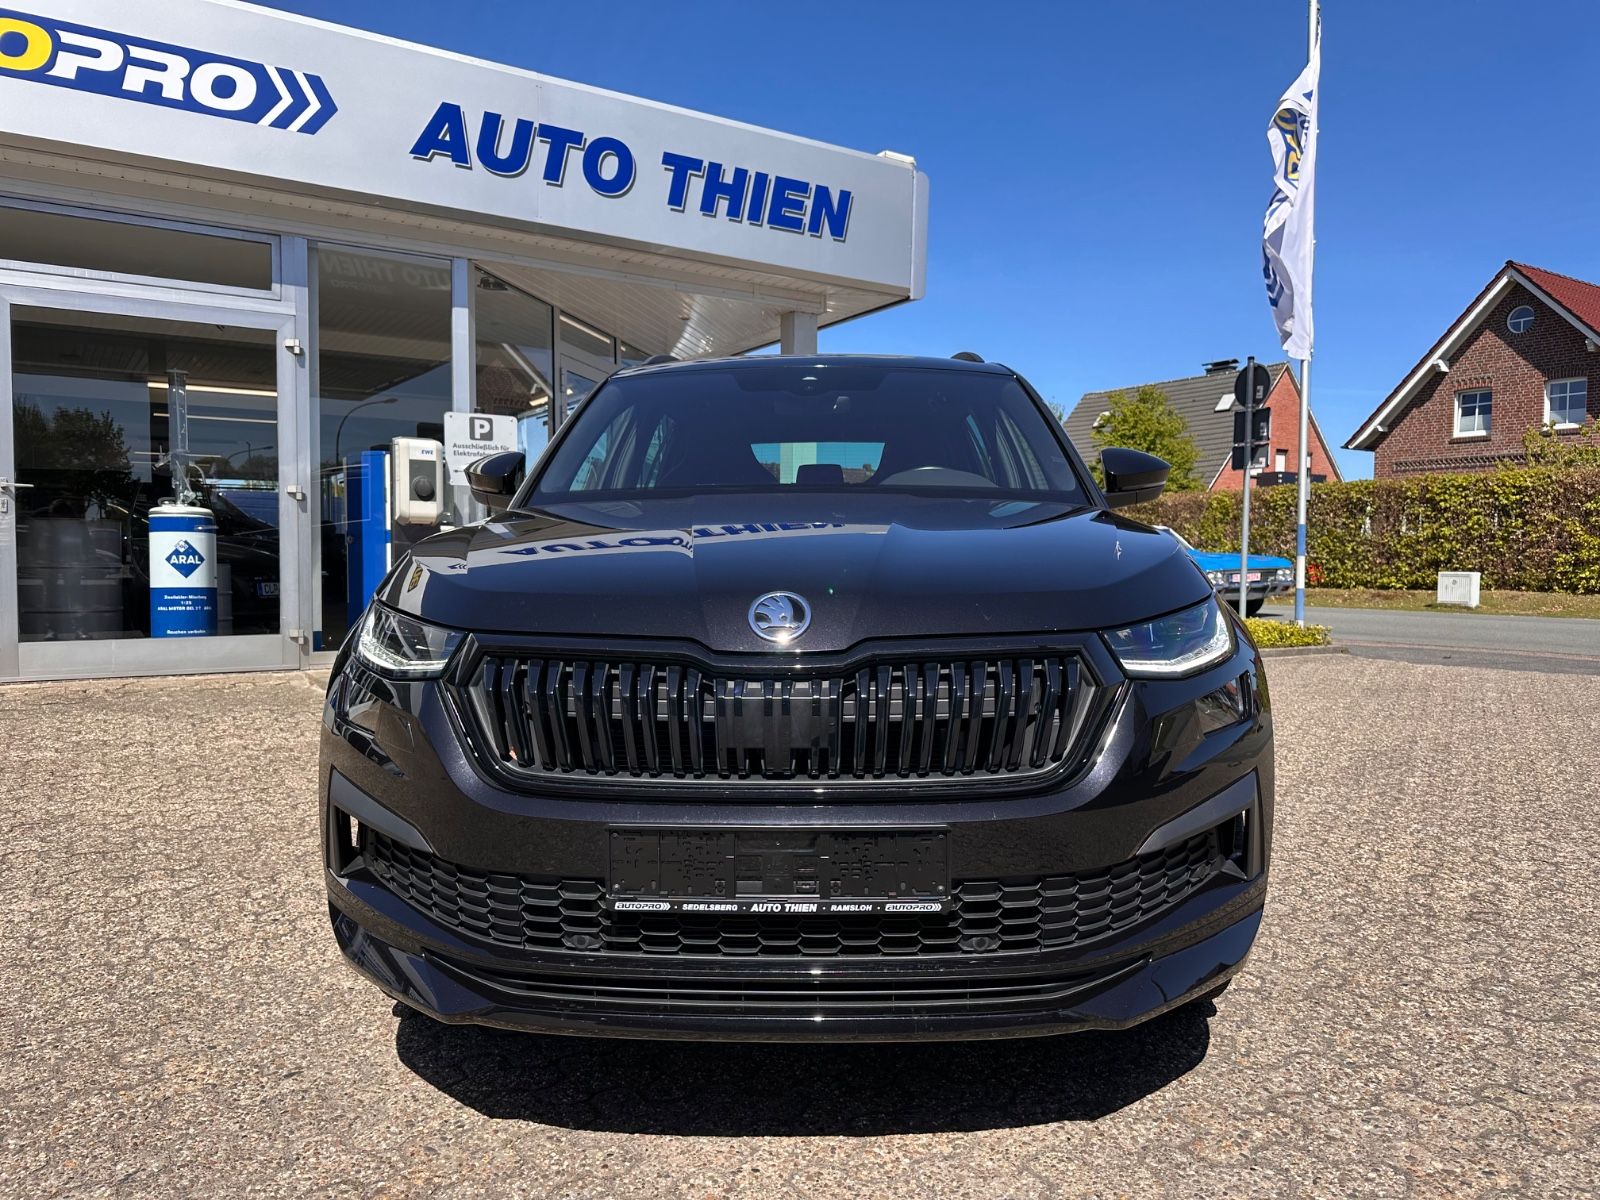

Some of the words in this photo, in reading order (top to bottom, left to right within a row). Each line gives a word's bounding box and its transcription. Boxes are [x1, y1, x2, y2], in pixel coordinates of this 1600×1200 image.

[409, 101, 636, 198] AUTO
[661, 151, 854, 241] THIEN
[474, 419, 491, 440] P
[453, 442, 499, 451] Ausschließlich
[170, 554, 202, 565] ARAL
[682, 903, 738, 912] SEDELSBERG
[750, 903, 781, 913] AUTO
[784, 903, 818, 913] THIEN
[830, 904, 873, 912] RAMSLOH
